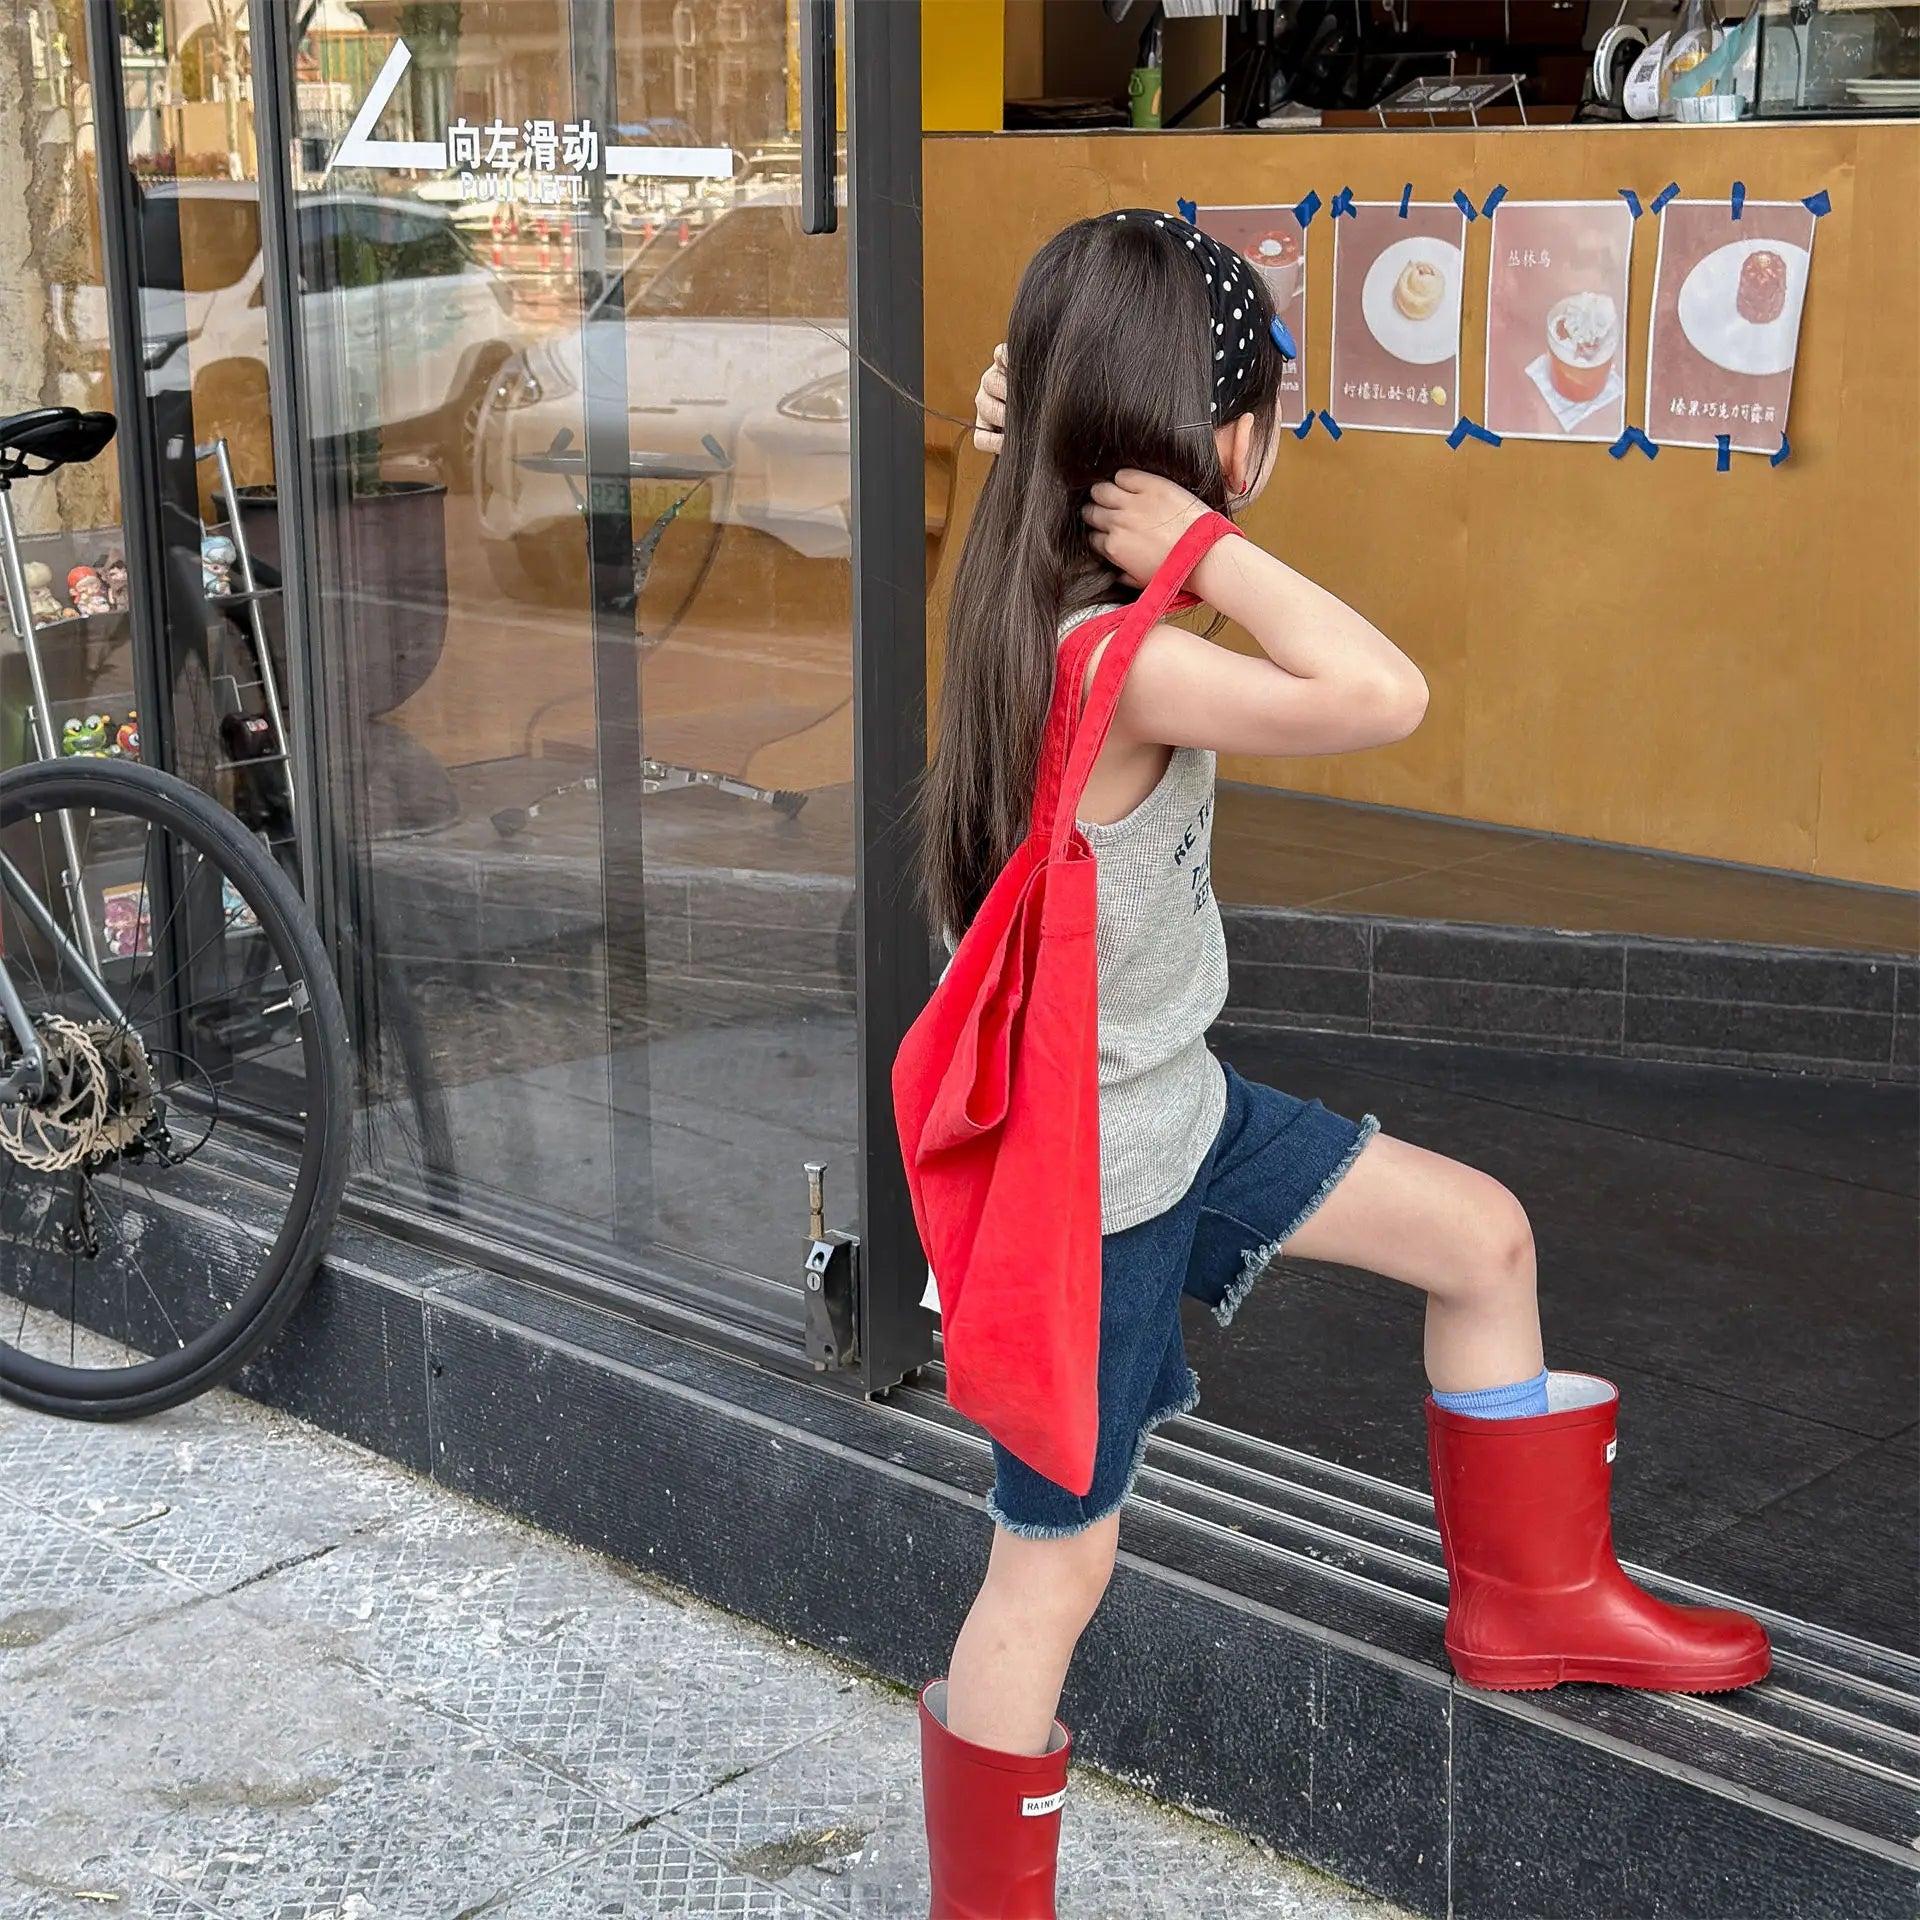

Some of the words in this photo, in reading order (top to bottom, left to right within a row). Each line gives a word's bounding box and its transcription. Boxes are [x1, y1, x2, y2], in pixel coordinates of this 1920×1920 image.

[448, 117, 599, 172] 向左滑动
[461, 171, 518, 200] PULL
[528, 174, 582, 205] LEFT
[1027, 1798, 1055, 1810] RAINY
